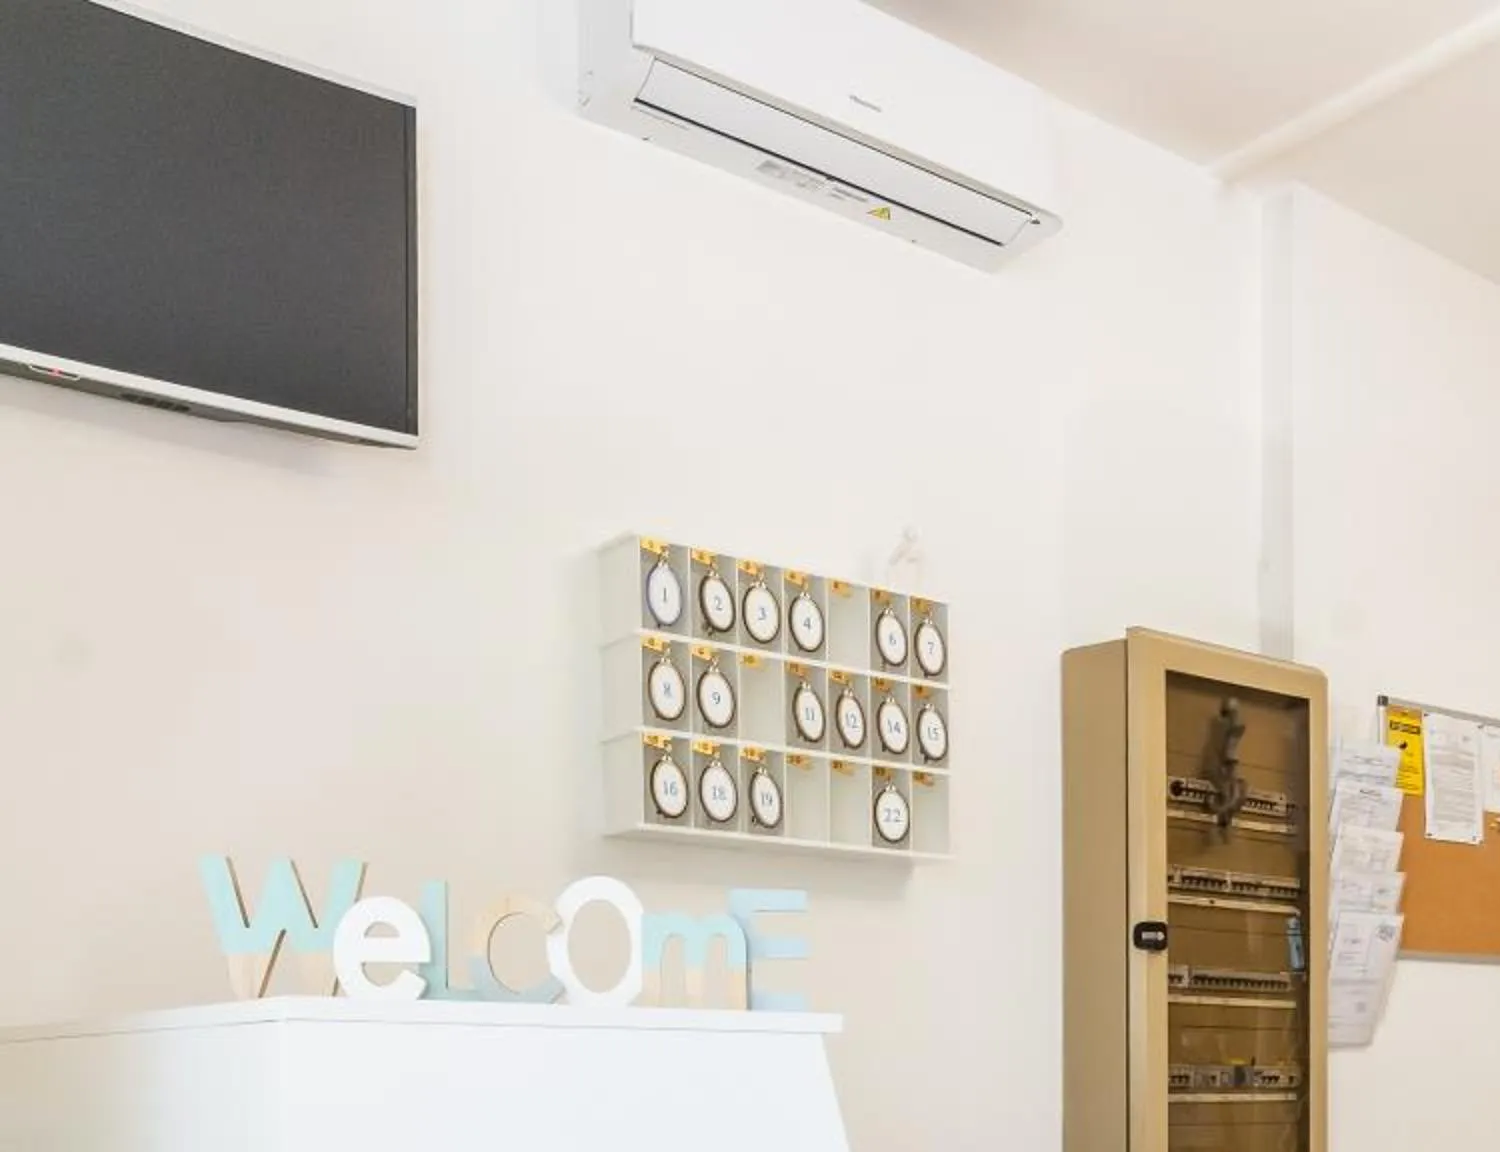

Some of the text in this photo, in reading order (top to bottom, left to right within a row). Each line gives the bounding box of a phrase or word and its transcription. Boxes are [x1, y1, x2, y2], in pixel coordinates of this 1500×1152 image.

[662, 587, 668, 603] 1
[713, 595, 724, 612] 2
[757, 606, 768, 621] 3
[802, 616, 812, 631] 4
[888, 633, 897, 646] 6
[926, 641, 935, 655] 7
[662, 683, 672, 698] 8
[710, 691, 722, 705] 9
[804, 706, 816, 722] 11
[844, 712, 859, 729] 12
[886, 718, 902, 734] 14
[663, 780, 678, 796] 16
[882, 807, 903, 824] 22
